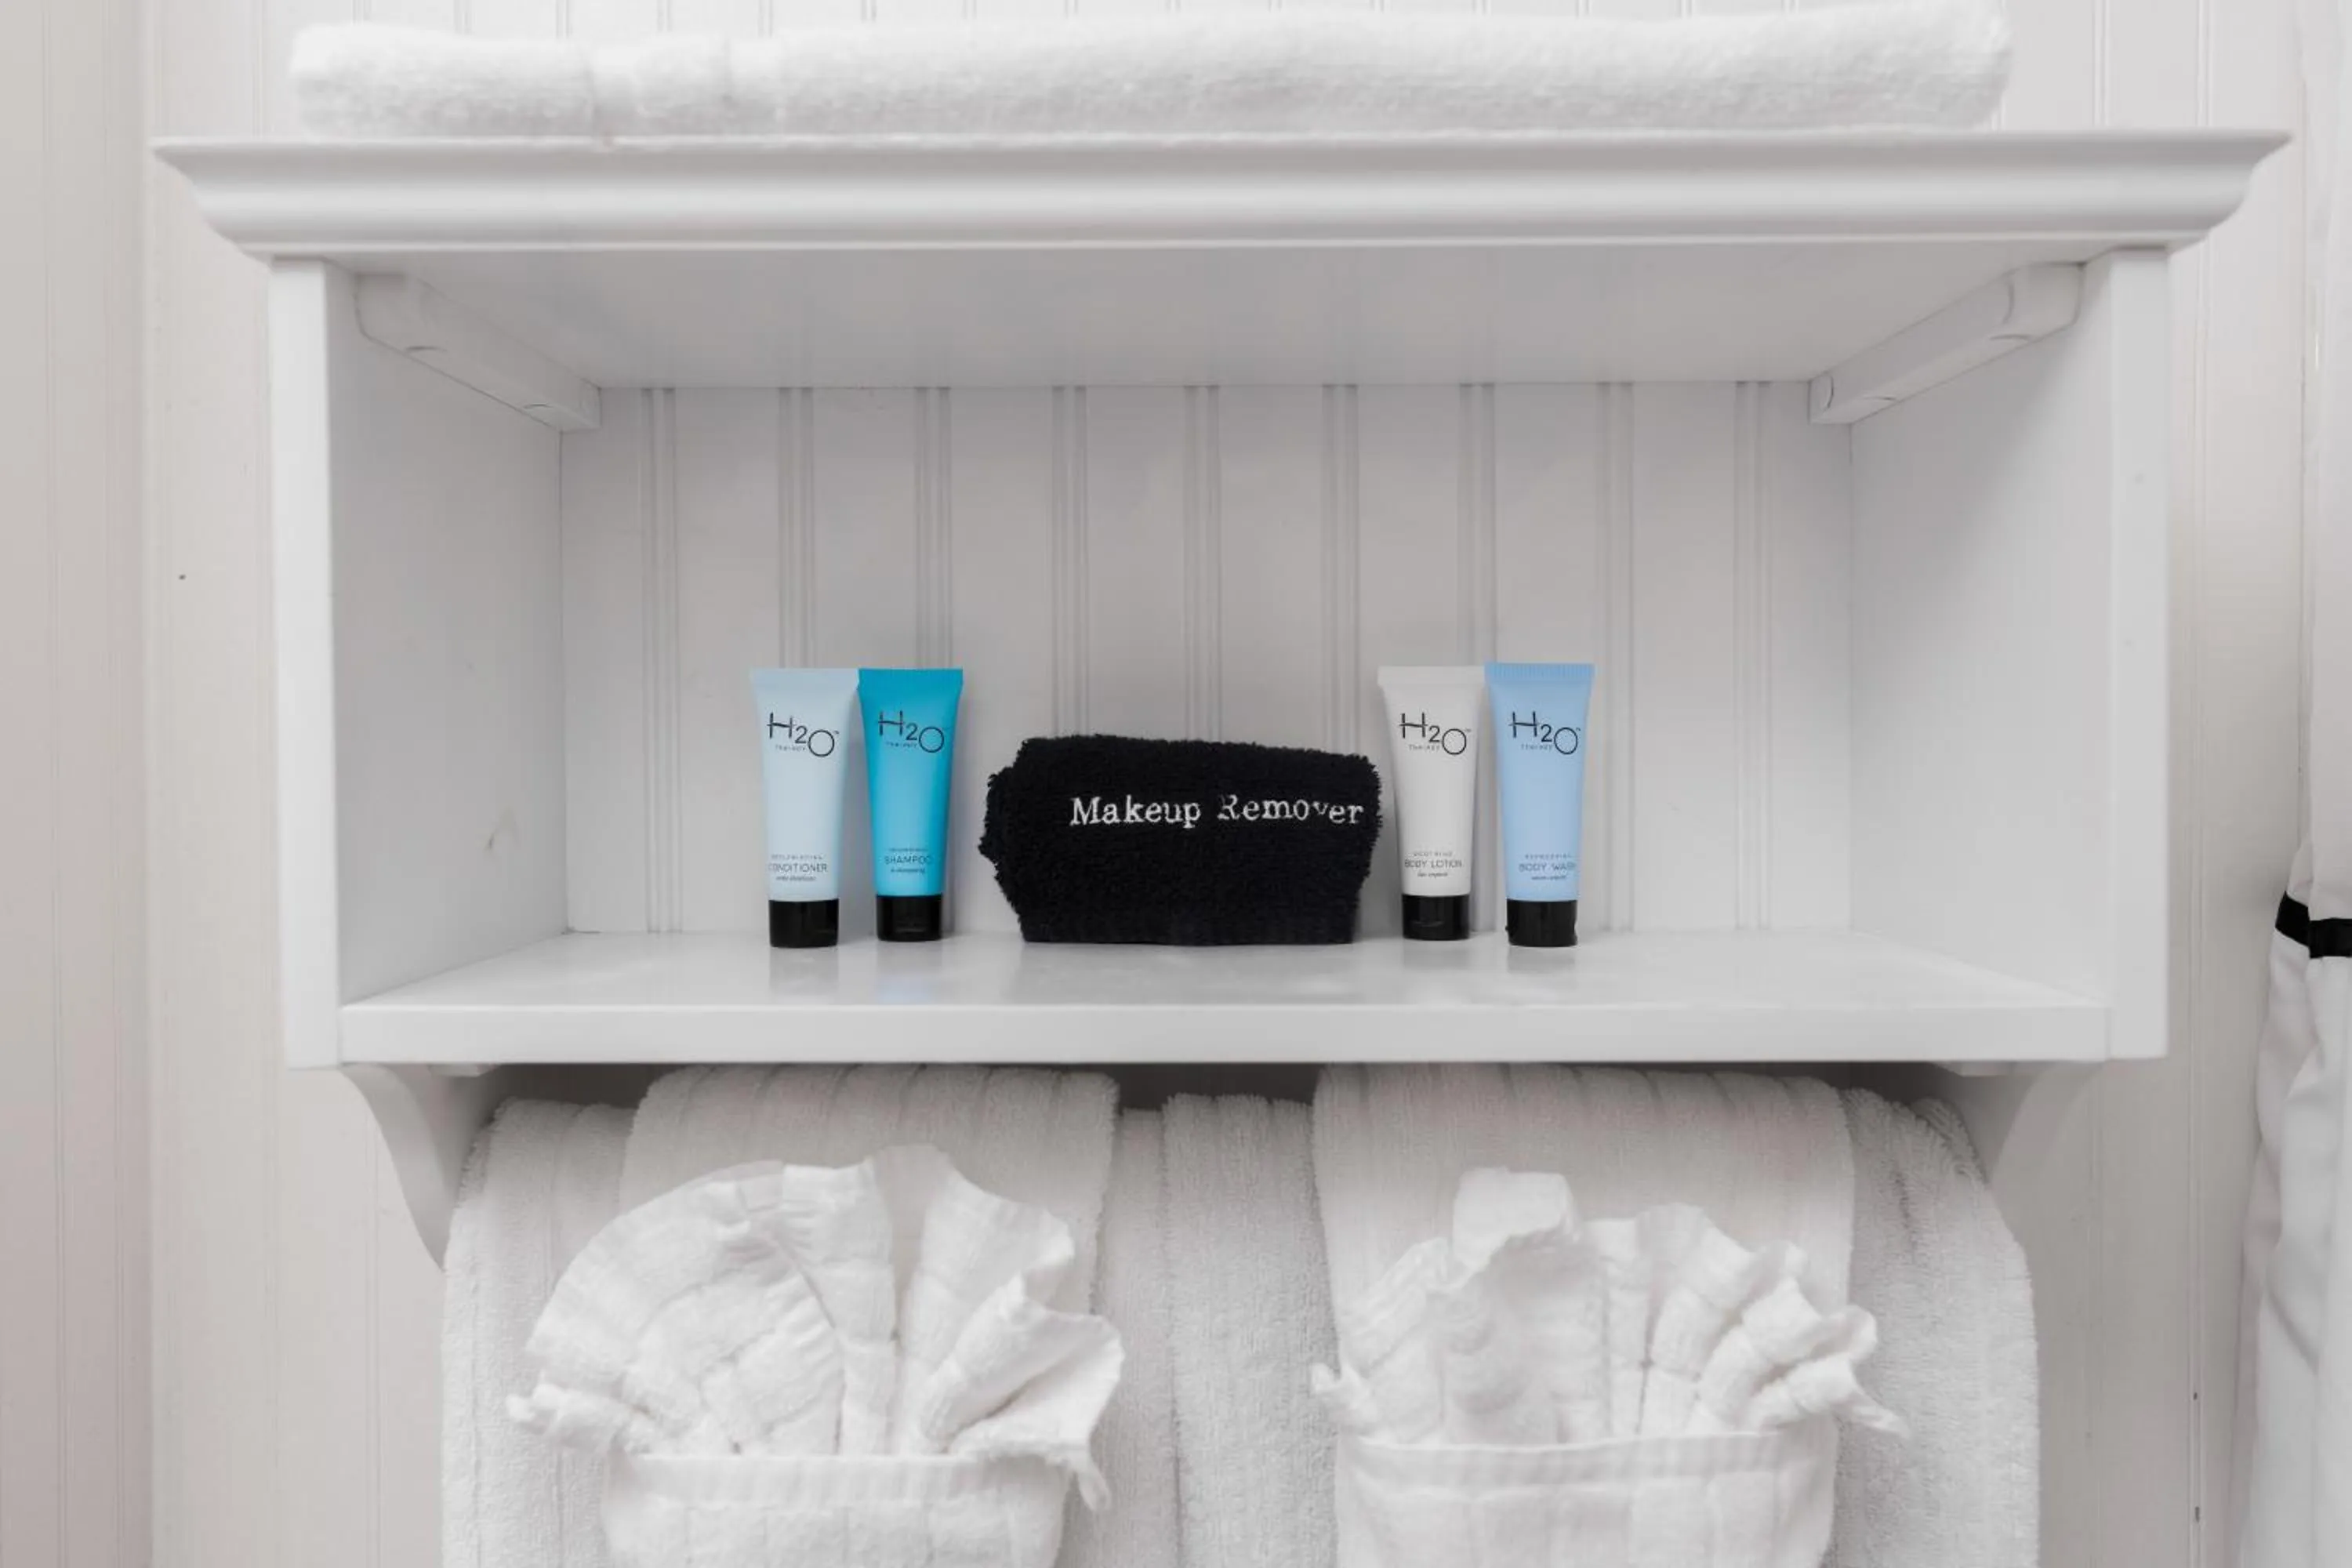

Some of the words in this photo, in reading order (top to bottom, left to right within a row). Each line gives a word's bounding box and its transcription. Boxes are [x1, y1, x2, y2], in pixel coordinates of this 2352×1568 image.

[767, 712, 835, 757] H2O
[877, 710, 945, 753] H2O
[1399, 712, 1467, 755] H2O
[1508, 711, 1578, 755] H2O
[1069, 794, 1201, 829] Makeup
[1217, 794, 1363, 825] Remover
